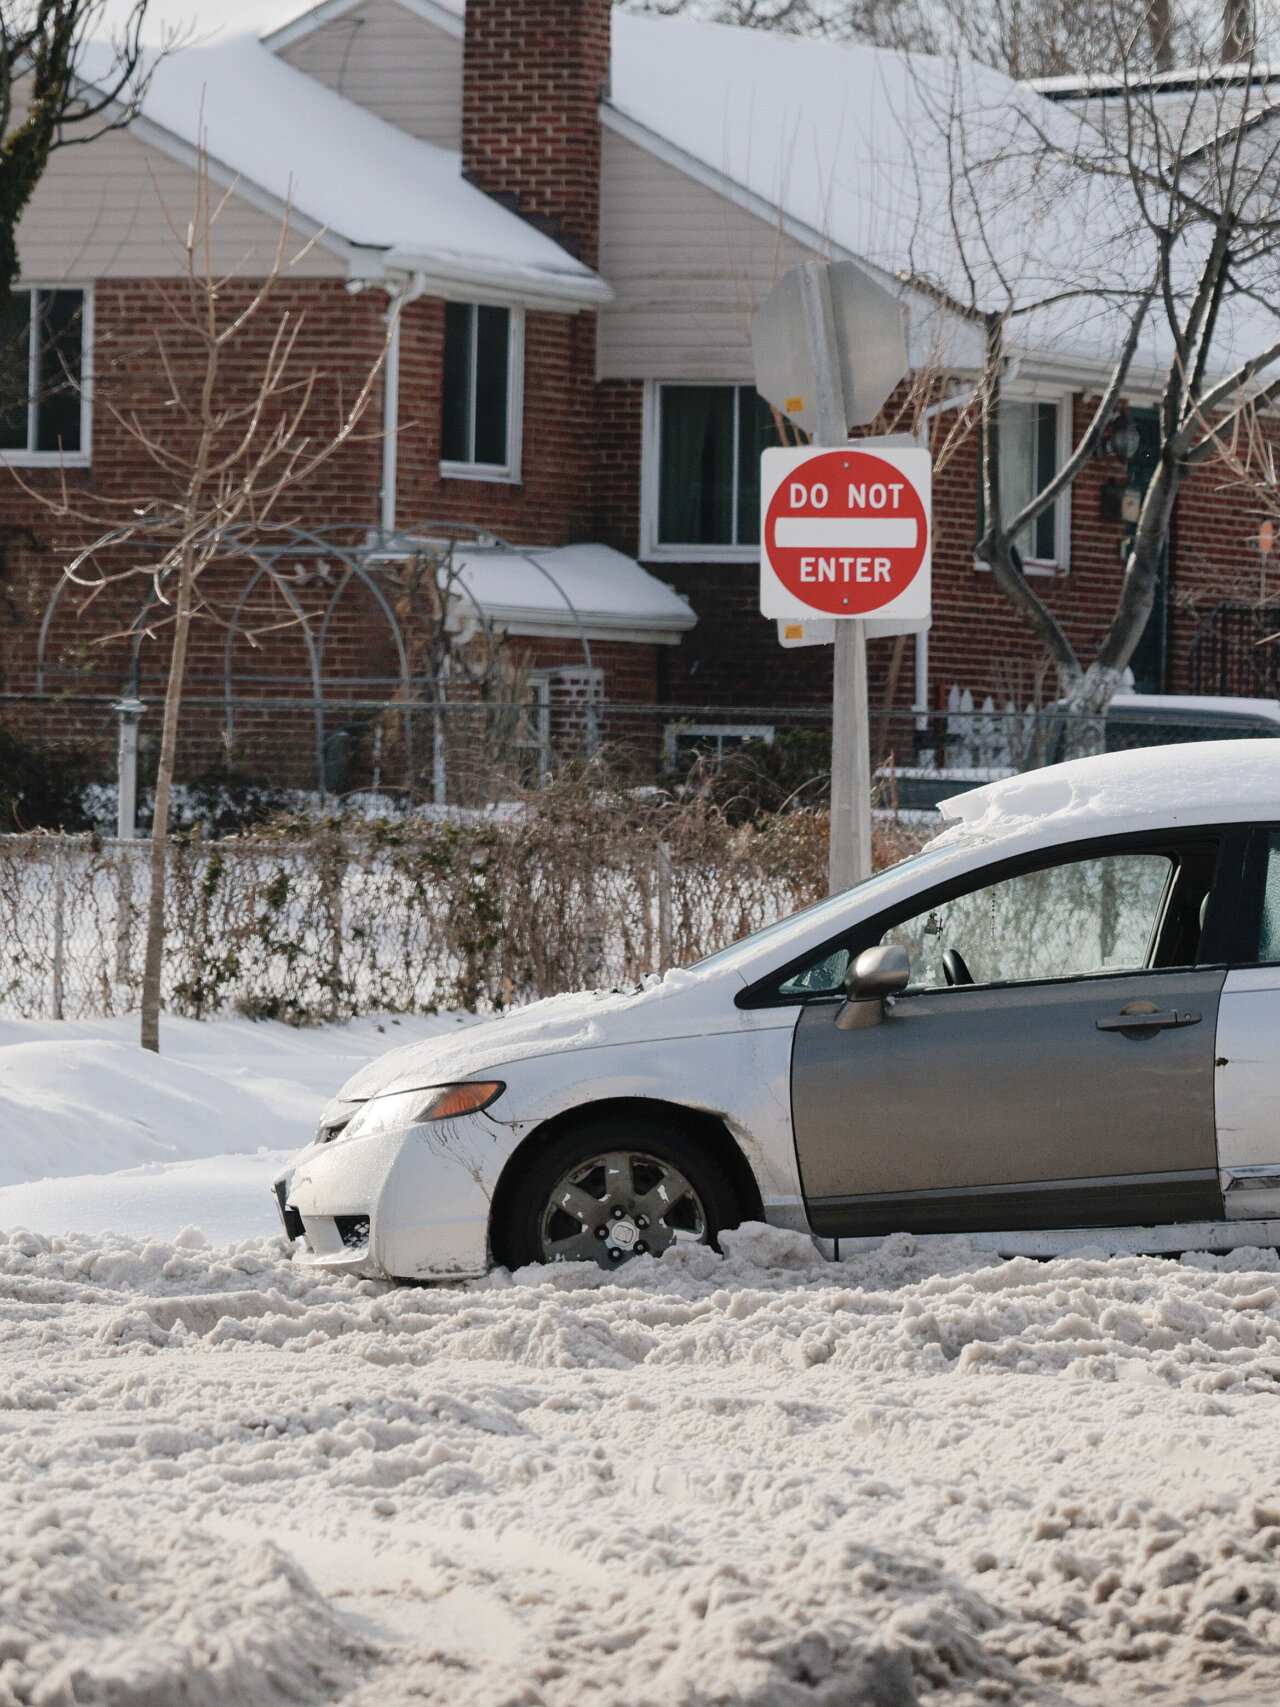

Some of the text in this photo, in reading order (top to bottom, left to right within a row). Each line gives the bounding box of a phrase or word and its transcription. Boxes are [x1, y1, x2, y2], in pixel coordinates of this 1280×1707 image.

[790, 483, 904, 509] DO NOT
[800, 557, 891, 583] ENTER
